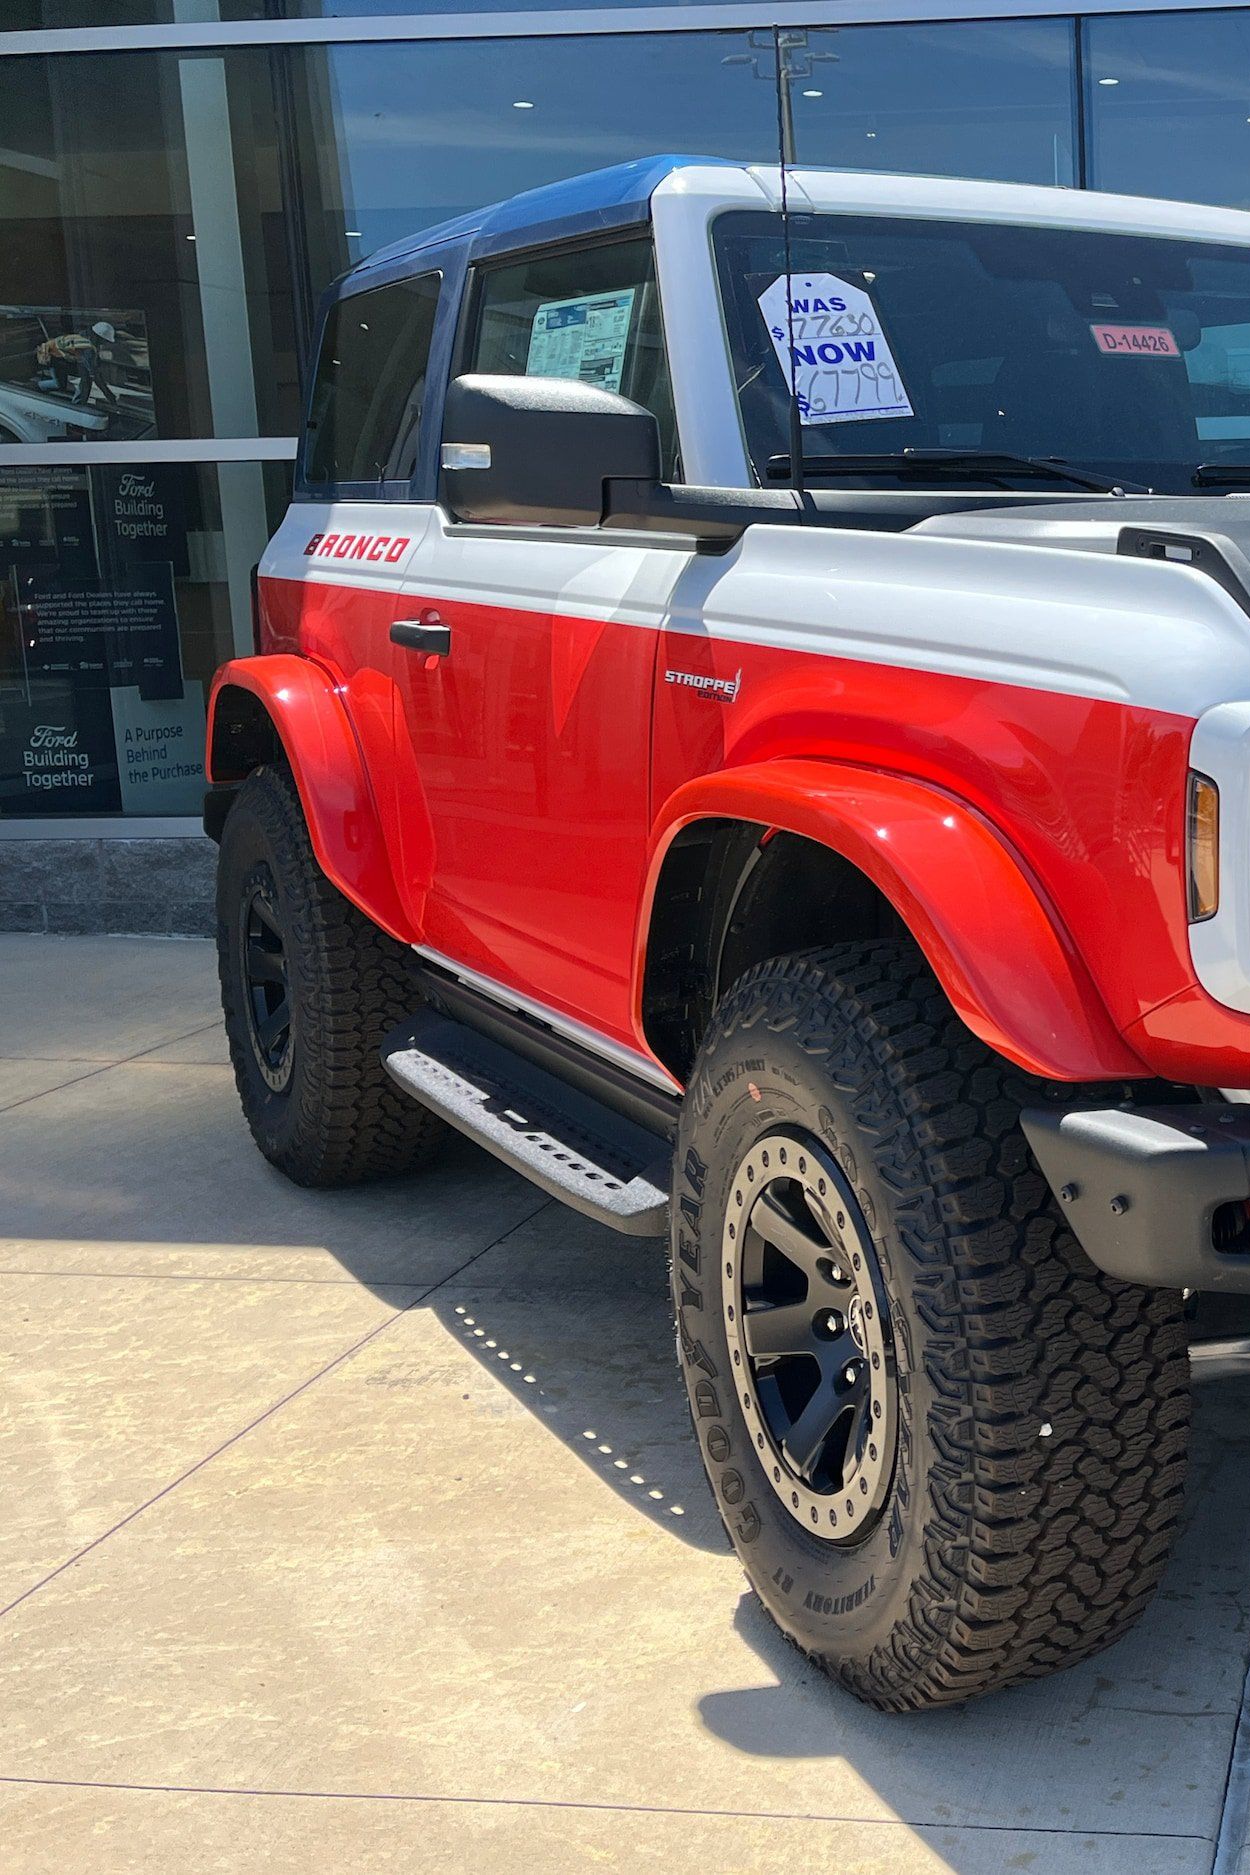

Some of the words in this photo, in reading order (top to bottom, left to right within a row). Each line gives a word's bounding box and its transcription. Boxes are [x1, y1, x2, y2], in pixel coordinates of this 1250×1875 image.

[786, 297, 847, 314] WAS
[771, 326, 785, 341] $
[1102, 332, 1170, 352] D-14426
[788, 341, 876, 367] NOW
[119, 473, 155, 497] Ford
[114, 499, 164, 519] Building
[114, 520, 168, 539] Together
[303, 533, 410, 563] BRONCO
[665, 670, 736, 695] STROPPE
[30, 724, 78, 748] Ford
[124, 729, 133, 743] A
[136, 724, 184, 743] Purpose
[23, 750, 89, 769] Building
[127, 744, 168, 764] Behind
[22, 769, 94, 790] Together
[128, 769, 149, 784] the
[152, 762, 203, 782] Purchase
[678, 1146, 761, 1545] GOODYEAR
